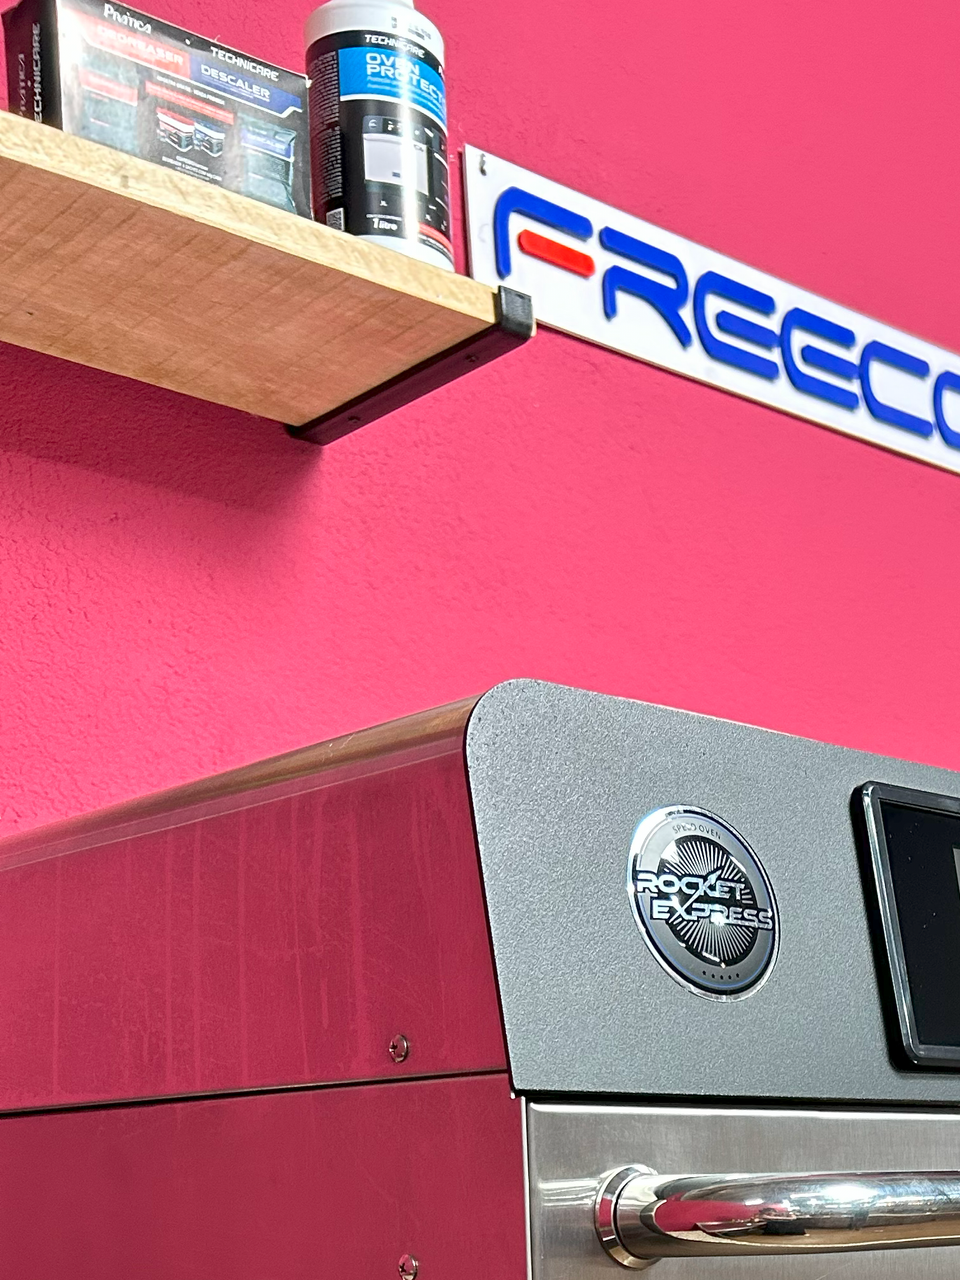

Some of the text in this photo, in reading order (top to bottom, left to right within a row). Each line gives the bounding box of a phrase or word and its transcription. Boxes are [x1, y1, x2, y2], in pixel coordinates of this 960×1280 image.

[33, 22, 43, 123] ECHNICARE
[210, 46, 280, 82] TECHNICARE
[366, 53, 420, 76] OVEN
[200, 64, 271, 99] DESCALER
[698, 824, 722, 840] OVEN
[636, 869, 745, 900] ROCKET
[651, 897, 773, 930] EXPRESS
